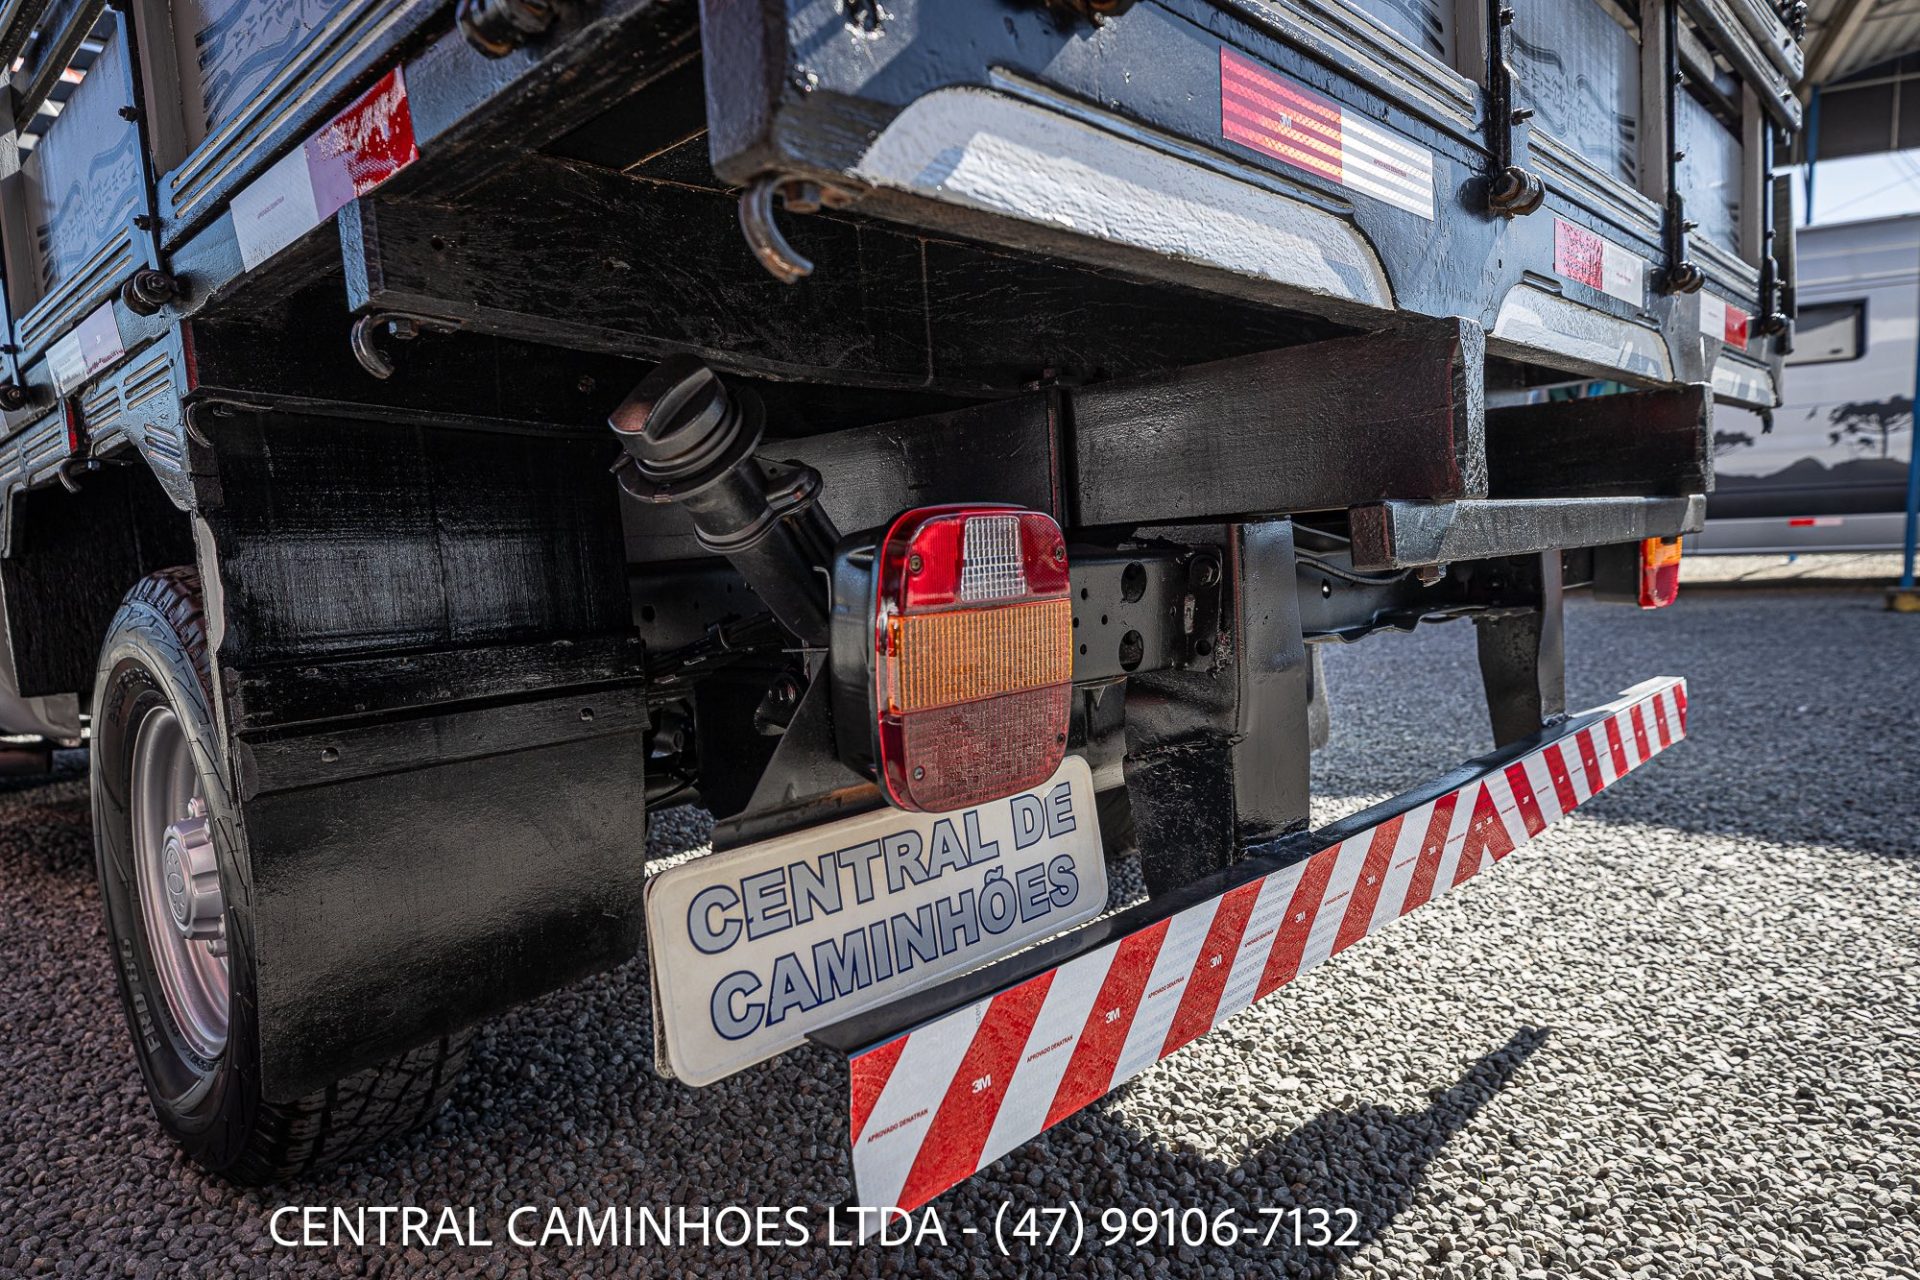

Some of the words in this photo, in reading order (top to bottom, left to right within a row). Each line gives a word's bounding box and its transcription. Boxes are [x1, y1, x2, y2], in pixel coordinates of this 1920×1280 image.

[687, 810, 1000, 955] CENTRAL
[1010, 781, 1077, 851] DE
[710, 854, 1079, 1041] CAMINHÕES
[1210, 953, 1222, 968] 3M
[1105, 1007, 1120, 1024] 3M
[1026, 1046, 1051, 1063] APROVADO
[972, 1073, 993, 1094] 3M
[867, 1122, 898, 1143] APROVADO
[899, 1108, 929, 1128] DENATRAN
